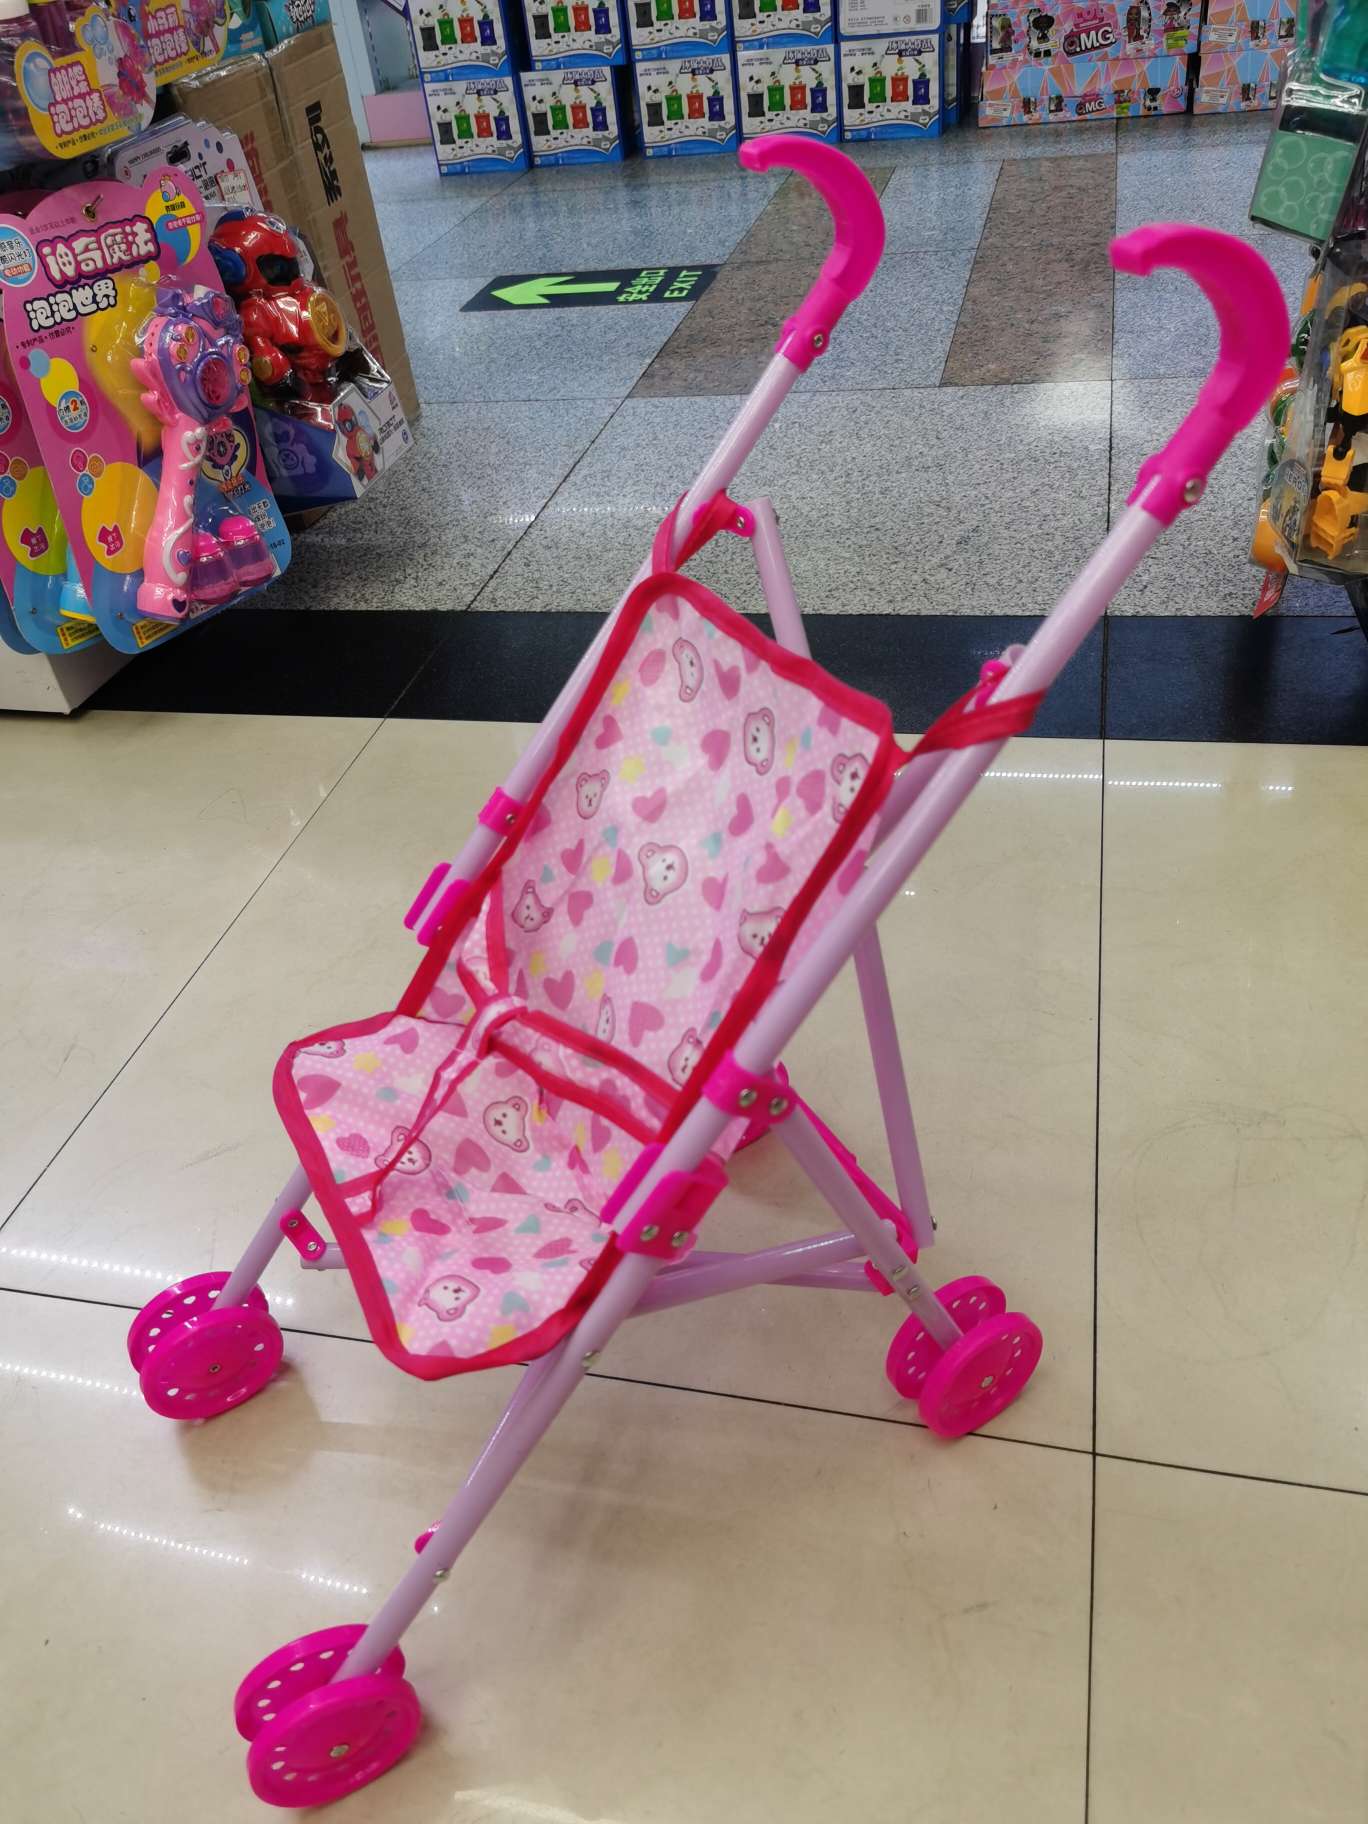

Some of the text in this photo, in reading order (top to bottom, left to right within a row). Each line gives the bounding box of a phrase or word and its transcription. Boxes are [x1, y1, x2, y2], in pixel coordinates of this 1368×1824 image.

[42, 221, 155, 280] 神奇魔法
[26, 278, 117, 331] 泡泡世界
[616, 269, 669, 302] 安全出口
[663, 270, 703, 298] EXIT
